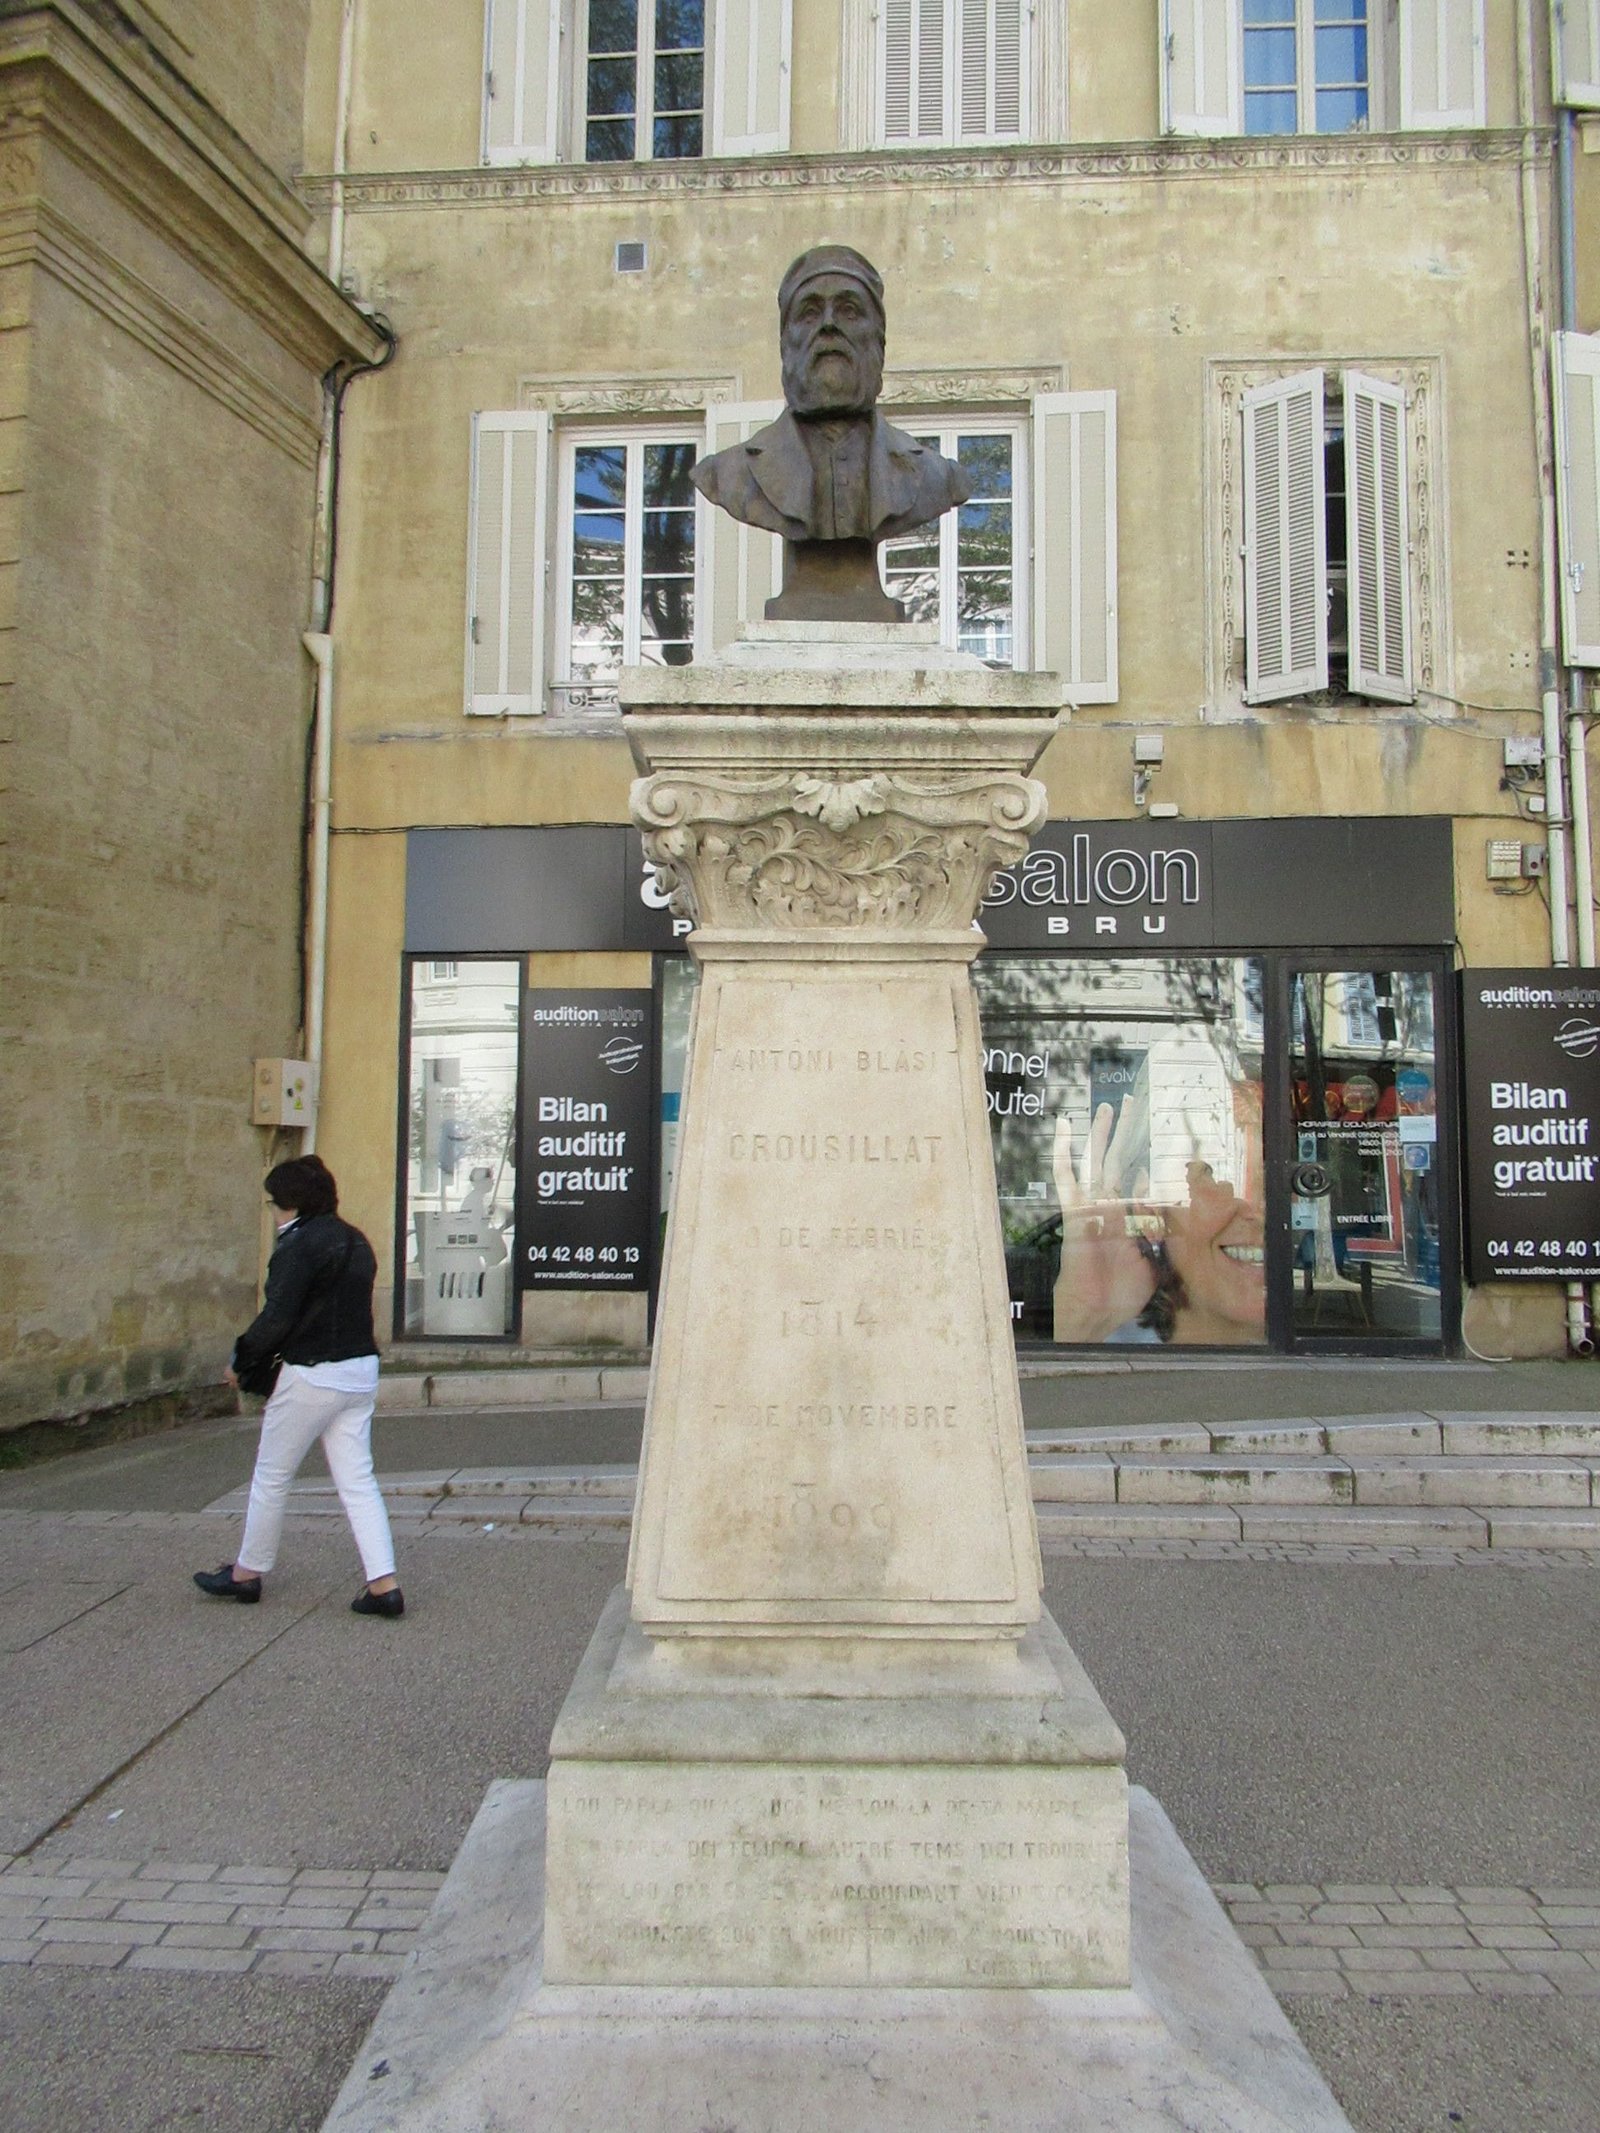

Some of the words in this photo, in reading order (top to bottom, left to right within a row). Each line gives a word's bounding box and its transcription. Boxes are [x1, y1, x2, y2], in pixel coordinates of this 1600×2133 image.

[1047, 916, 1165, 934] BRU
[983, 1049, 1050, 1078] nnel
[1490, 1082, 1567, 1109] Bilan
[539, 1097, 608, 1122] Bilan
[538, 1131, 627, 1157] auditif
[1493, 1118, 1589, 1146] auditif
[728, 1133, 943, 1164] CROUSILLAT
[779, 1227, 810, 1249] DE
[1487, 1240, 1509, 1257] 04
[1514, 1240, 1535, 1257] 42
[1539, 1240, 1561, 1257] 48
[1565, 1240, 1587, 1257] 40
[528, 1246, 548, 1261] 04
[552, 1246, 571, 1261] 42
[574, 1247, 594, 1262] 48
[598, 1247, 618, 1262] 40
[623, 1247, 640, 1262] 13
[534, 1271, 634, 1280] www.audition-salon.com
